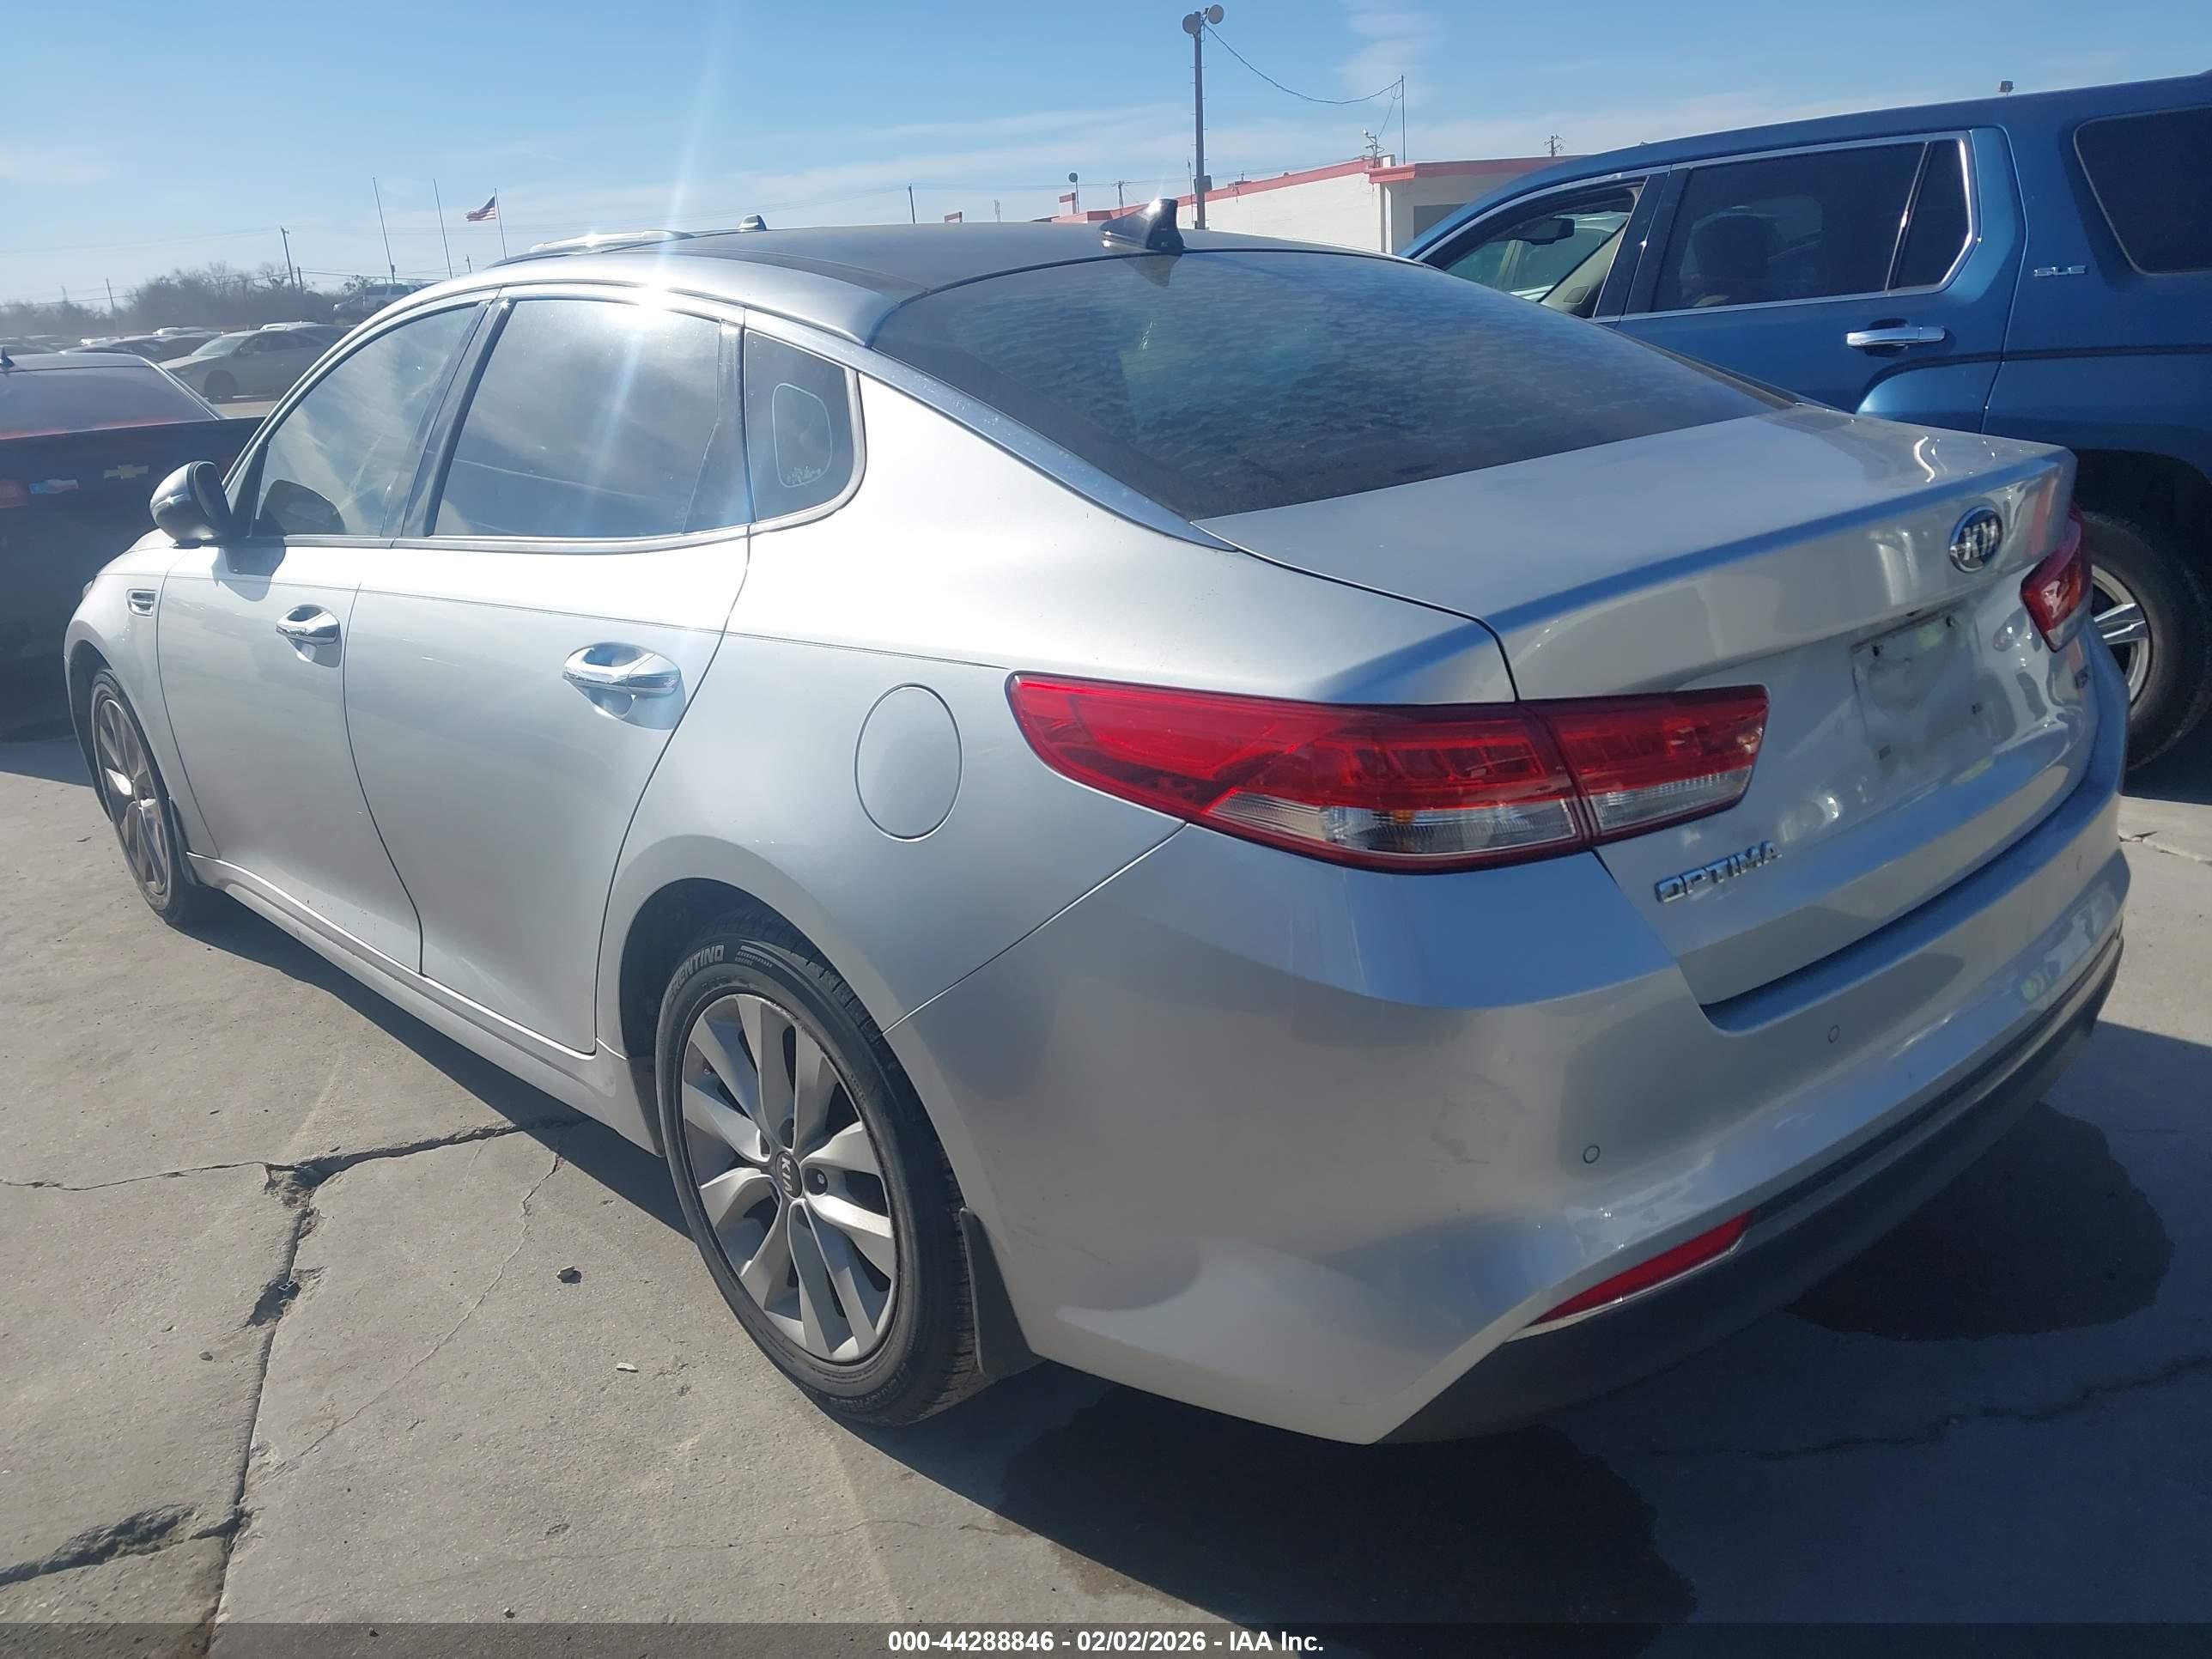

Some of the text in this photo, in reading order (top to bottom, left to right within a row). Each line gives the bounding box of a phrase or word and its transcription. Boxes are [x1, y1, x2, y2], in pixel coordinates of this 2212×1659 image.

[1961, 518, 1999, 561] KIA
[1655, 841, 1783, 902] OPTIMA
[781, 1156, 793, 1192] KIA
